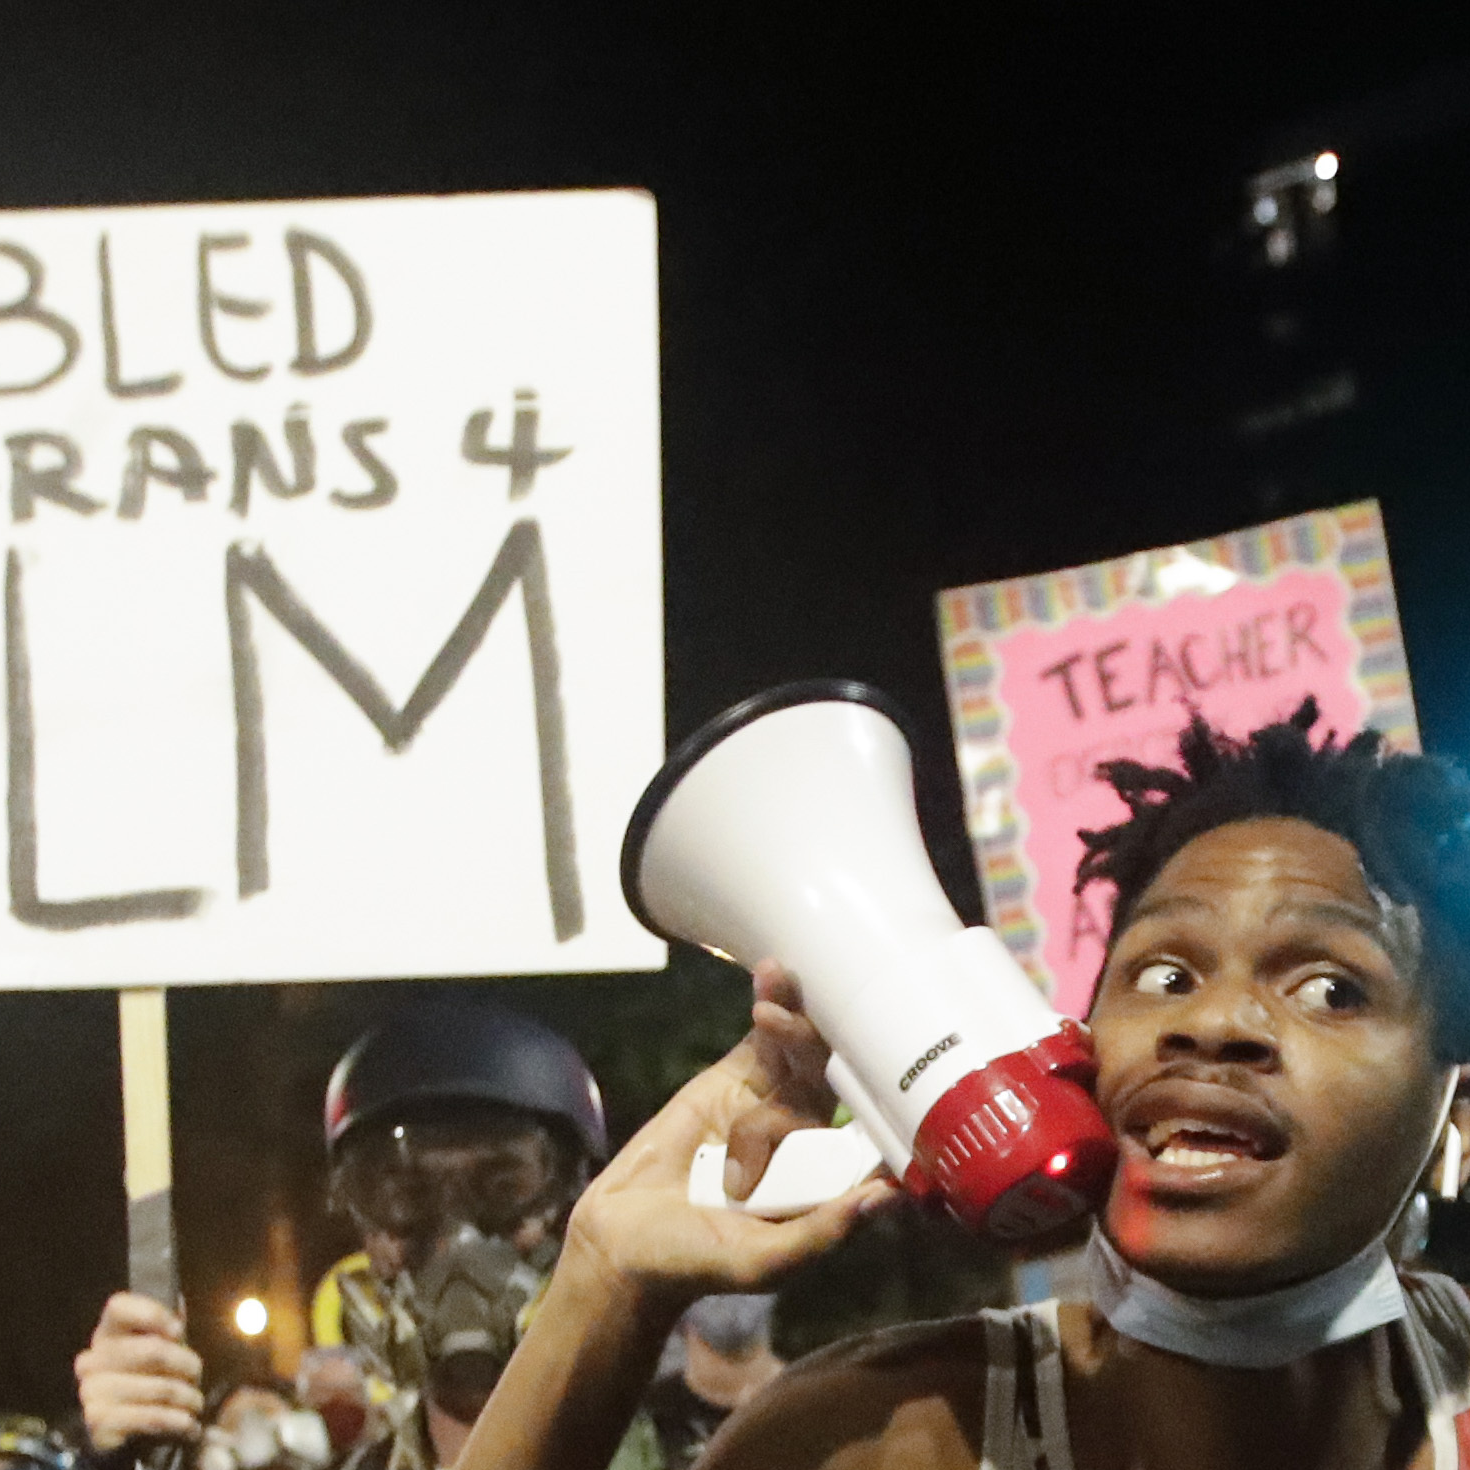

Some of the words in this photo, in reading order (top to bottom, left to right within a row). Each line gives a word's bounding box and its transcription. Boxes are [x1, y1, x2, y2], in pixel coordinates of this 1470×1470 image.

[461, 388, 571, 499] 4
[1038, 602, 1328, 720] TEACHER
[899, 1032, 963, 1093] CROOVE
